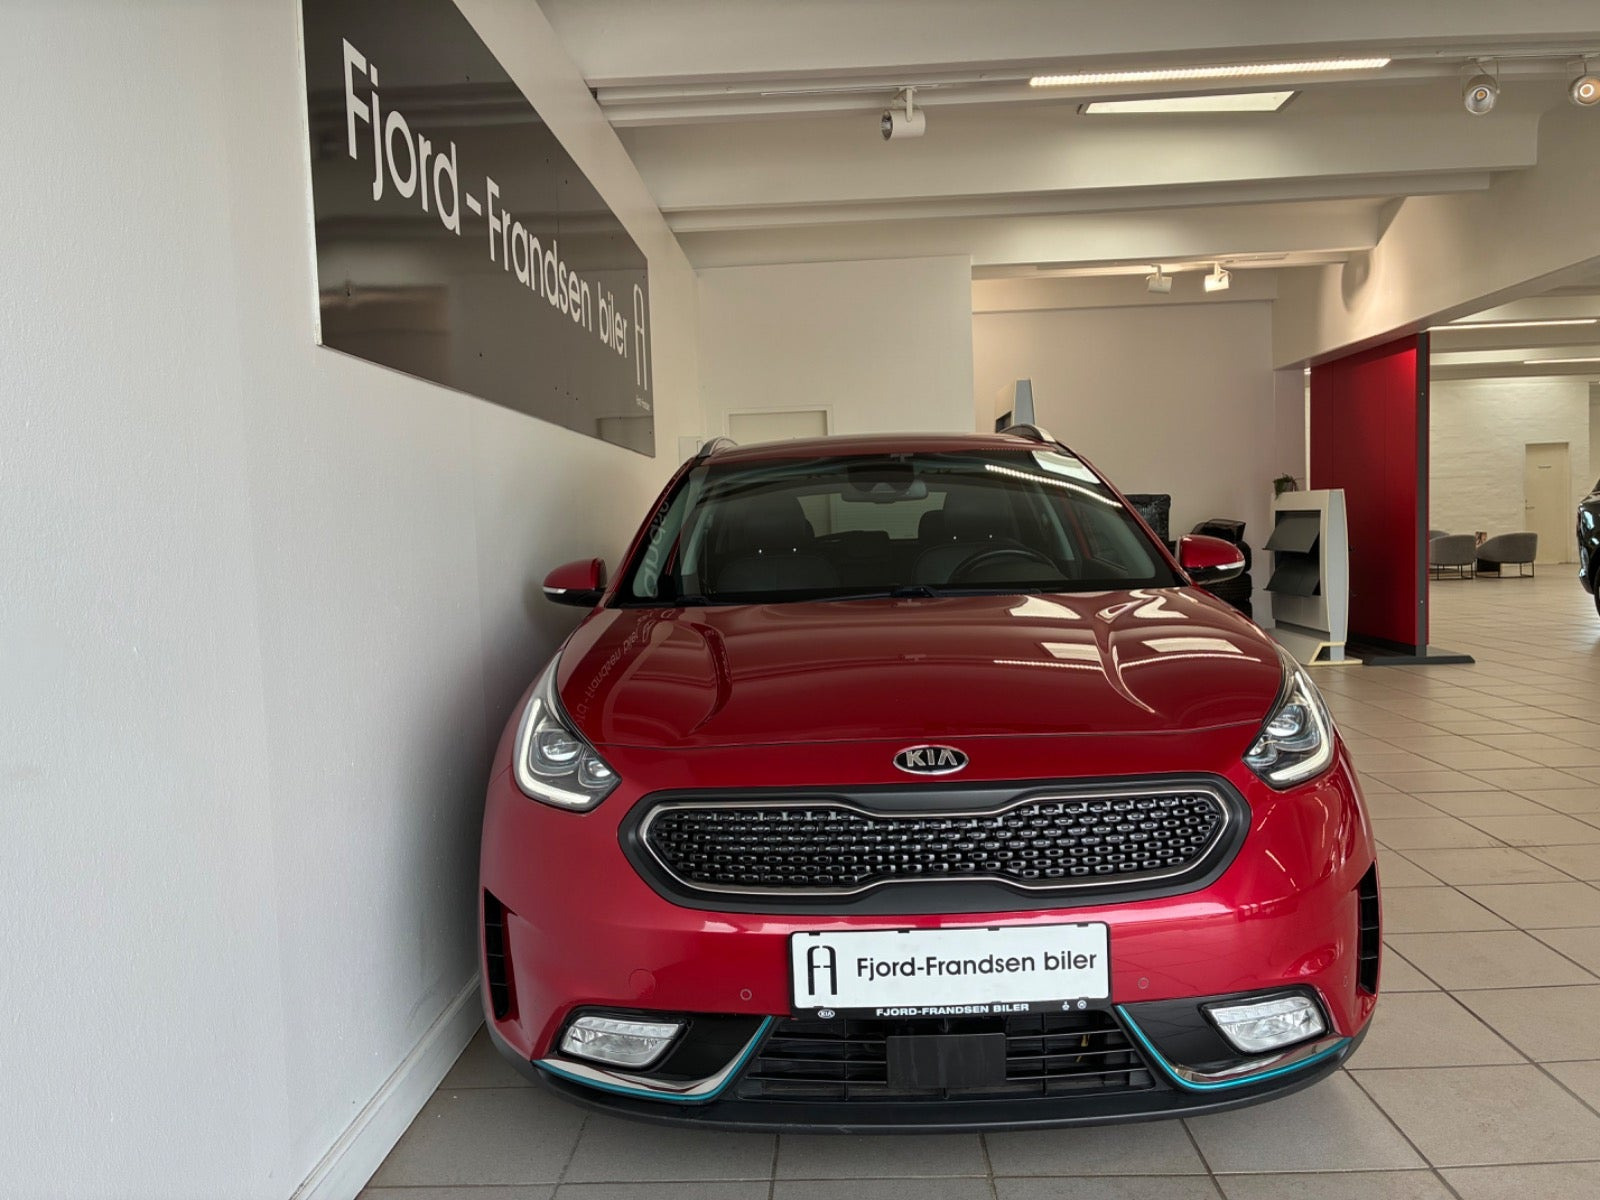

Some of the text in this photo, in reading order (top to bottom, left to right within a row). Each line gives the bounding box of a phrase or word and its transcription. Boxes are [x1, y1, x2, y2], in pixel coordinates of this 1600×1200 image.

[343, 38, 627, 358] Fjord-Frandsen biler
[906, 749, 958, 767] KIA
[856, 950, 1097, 981] Fjord-Frandsen biler
[820, 1009, 833, 1017] KIA
[876, 1003, 1029, 1017] FJORD-FRANDSEN BILER
